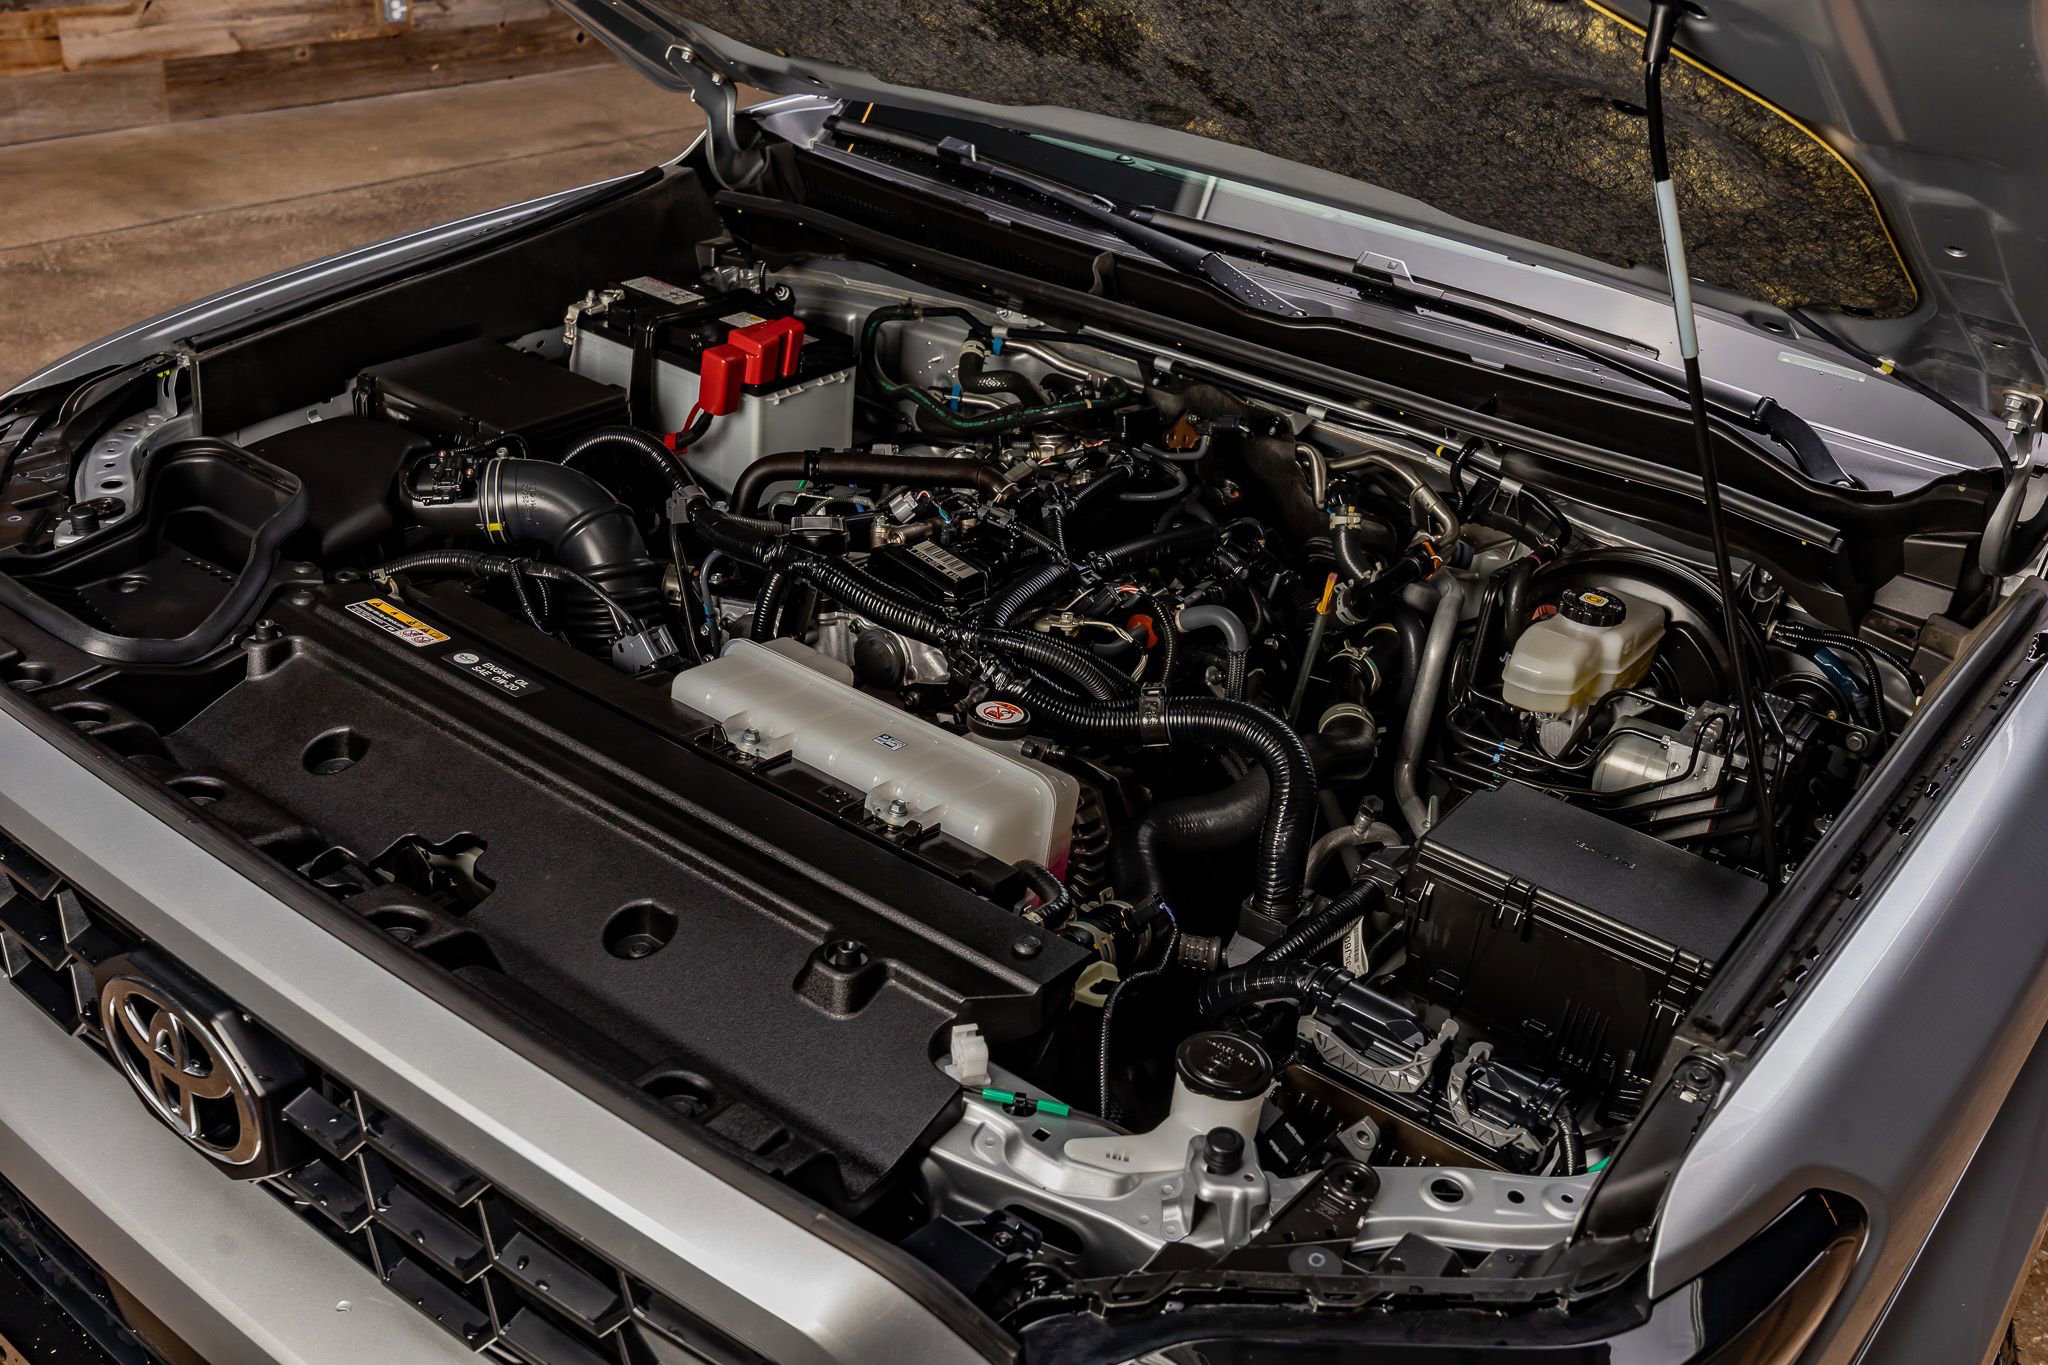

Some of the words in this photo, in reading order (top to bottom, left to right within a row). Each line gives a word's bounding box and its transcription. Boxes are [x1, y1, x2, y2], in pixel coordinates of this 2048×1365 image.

[471, 665, 492, 677] SAE
[491, 676, 520, 691] 0W-20
[482, 662, 515, 680] ENGINE
[514, 679, 529, 689] OIL
